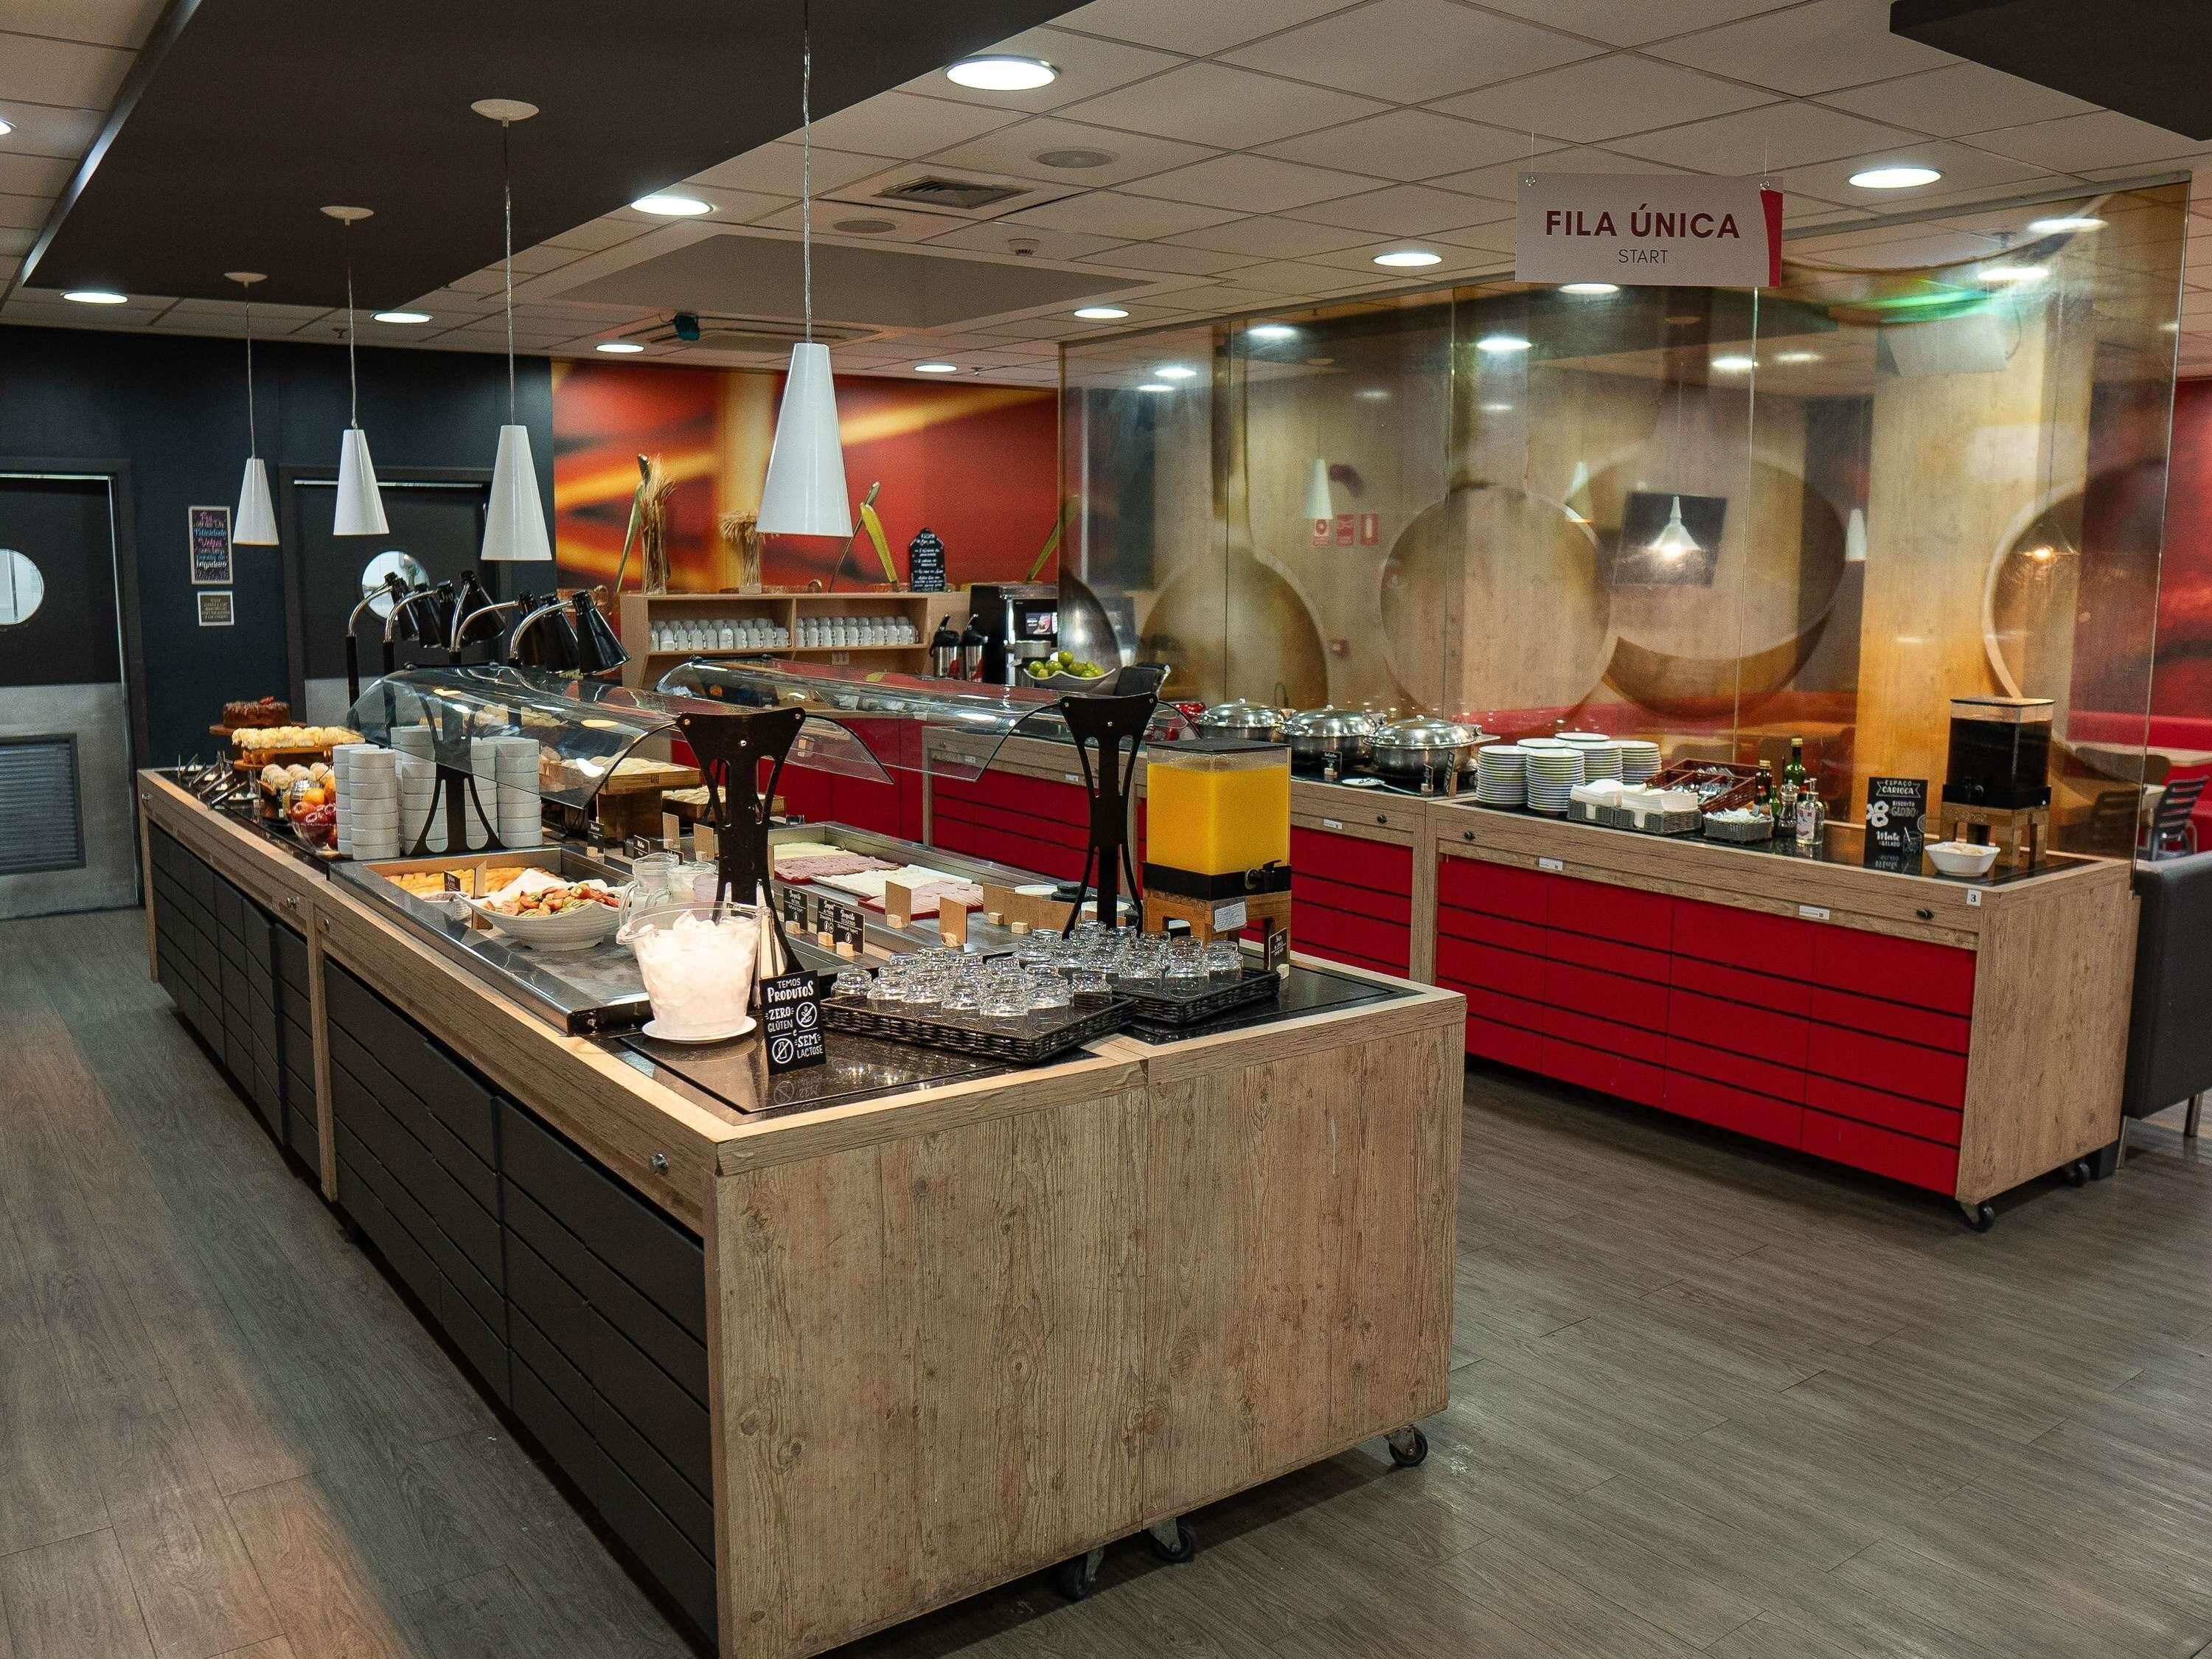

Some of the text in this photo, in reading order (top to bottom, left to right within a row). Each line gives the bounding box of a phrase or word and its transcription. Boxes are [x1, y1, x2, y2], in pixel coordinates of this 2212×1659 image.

[1546, 204, 1740, 239] FILA ÚNICA
[1618, 248, 1669, 264] START
[1882, 786, 1914, 795] CARIOCA
[1876, 830, 1900, 841] Mate
[1970, 894, 1977, 902] 3
[776, 978, 801, 989] TEMOS
[767, 981, 814, 1003] PRODUTOS
[768, 1006, 791, 1020] ZERO
[768, 1019, 793, 1032] GLÚTEN
[797, 1033, 818, 1048] SEM
[796, 1045, 824, 1059] LACTOSE
